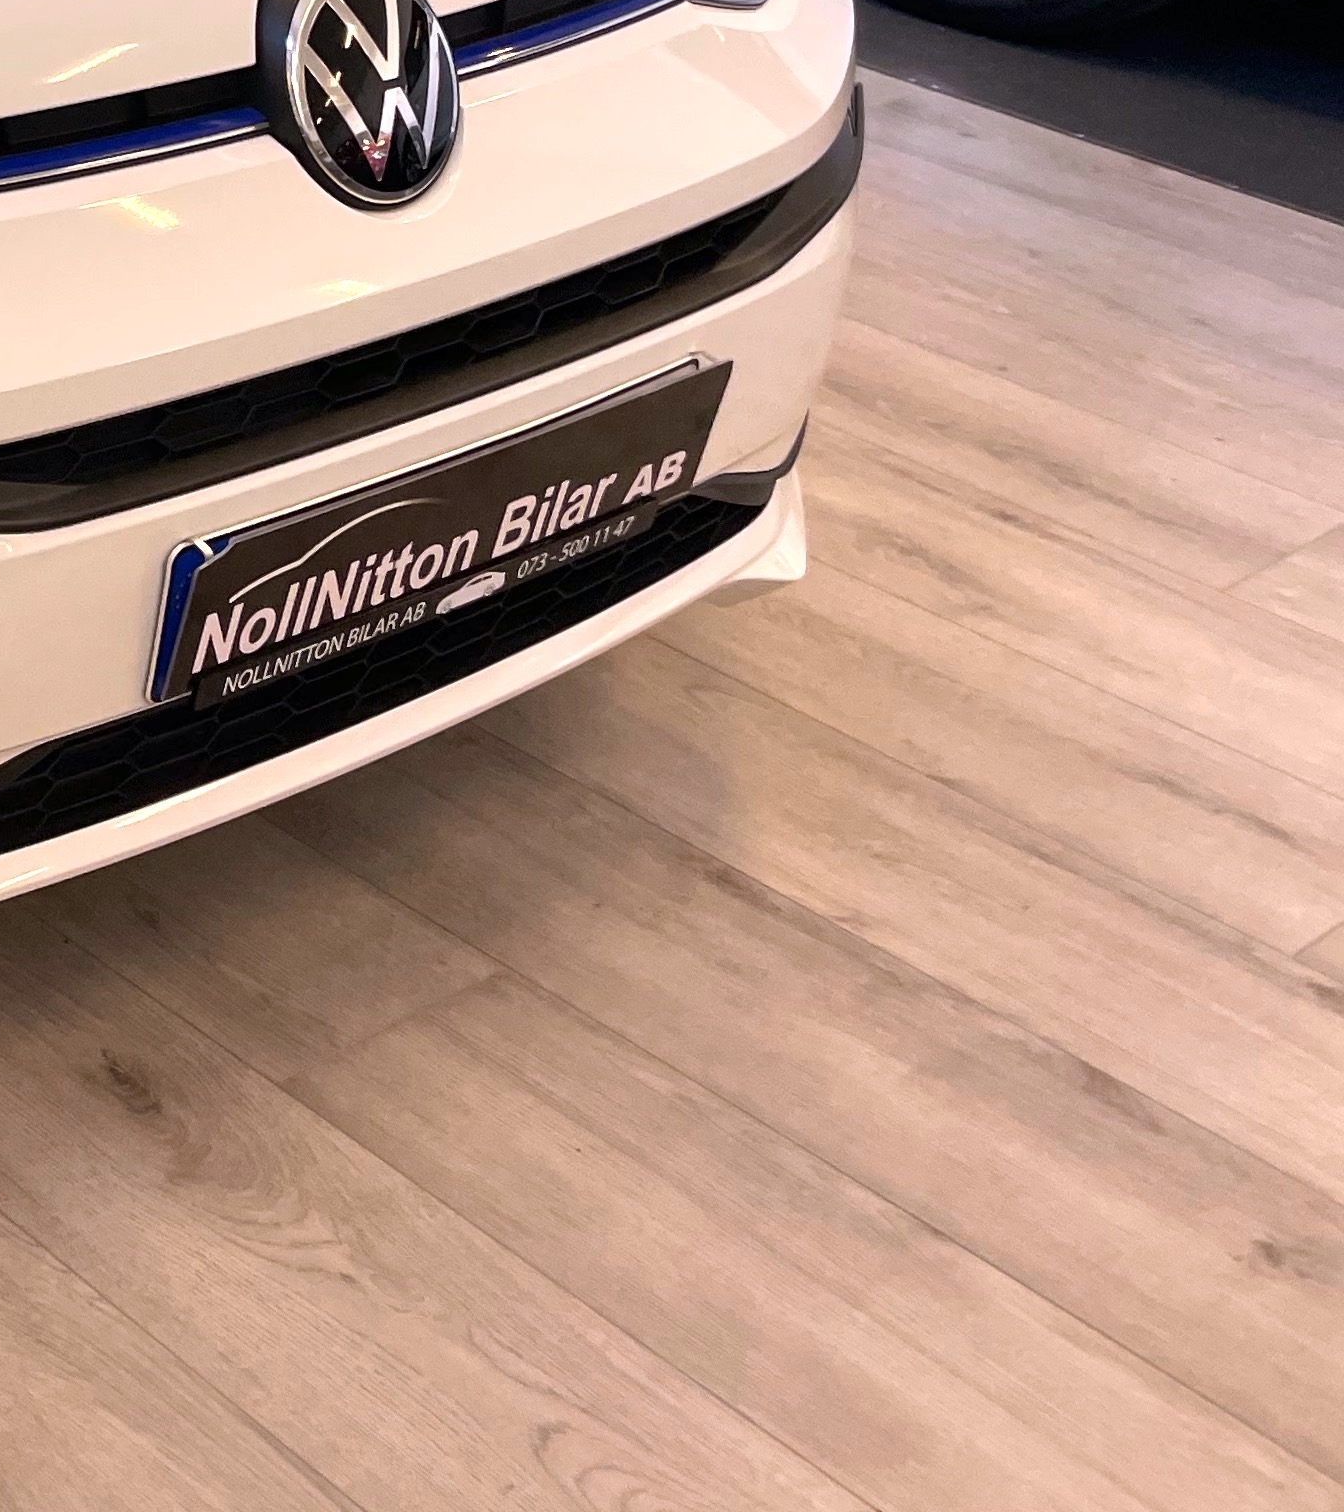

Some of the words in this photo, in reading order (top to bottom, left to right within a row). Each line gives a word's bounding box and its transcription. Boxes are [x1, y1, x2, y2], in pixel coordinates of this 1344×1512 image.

[191, 529, 479, 674] NollNitton
[491, 473, 618, 558] Bilar
[622, 450, 687, 505] AB
[222, 634, 344, 696] NOLLNITTON
[347, 612, 398, 648] BILAR
[400, 601, 426, 627] AB
